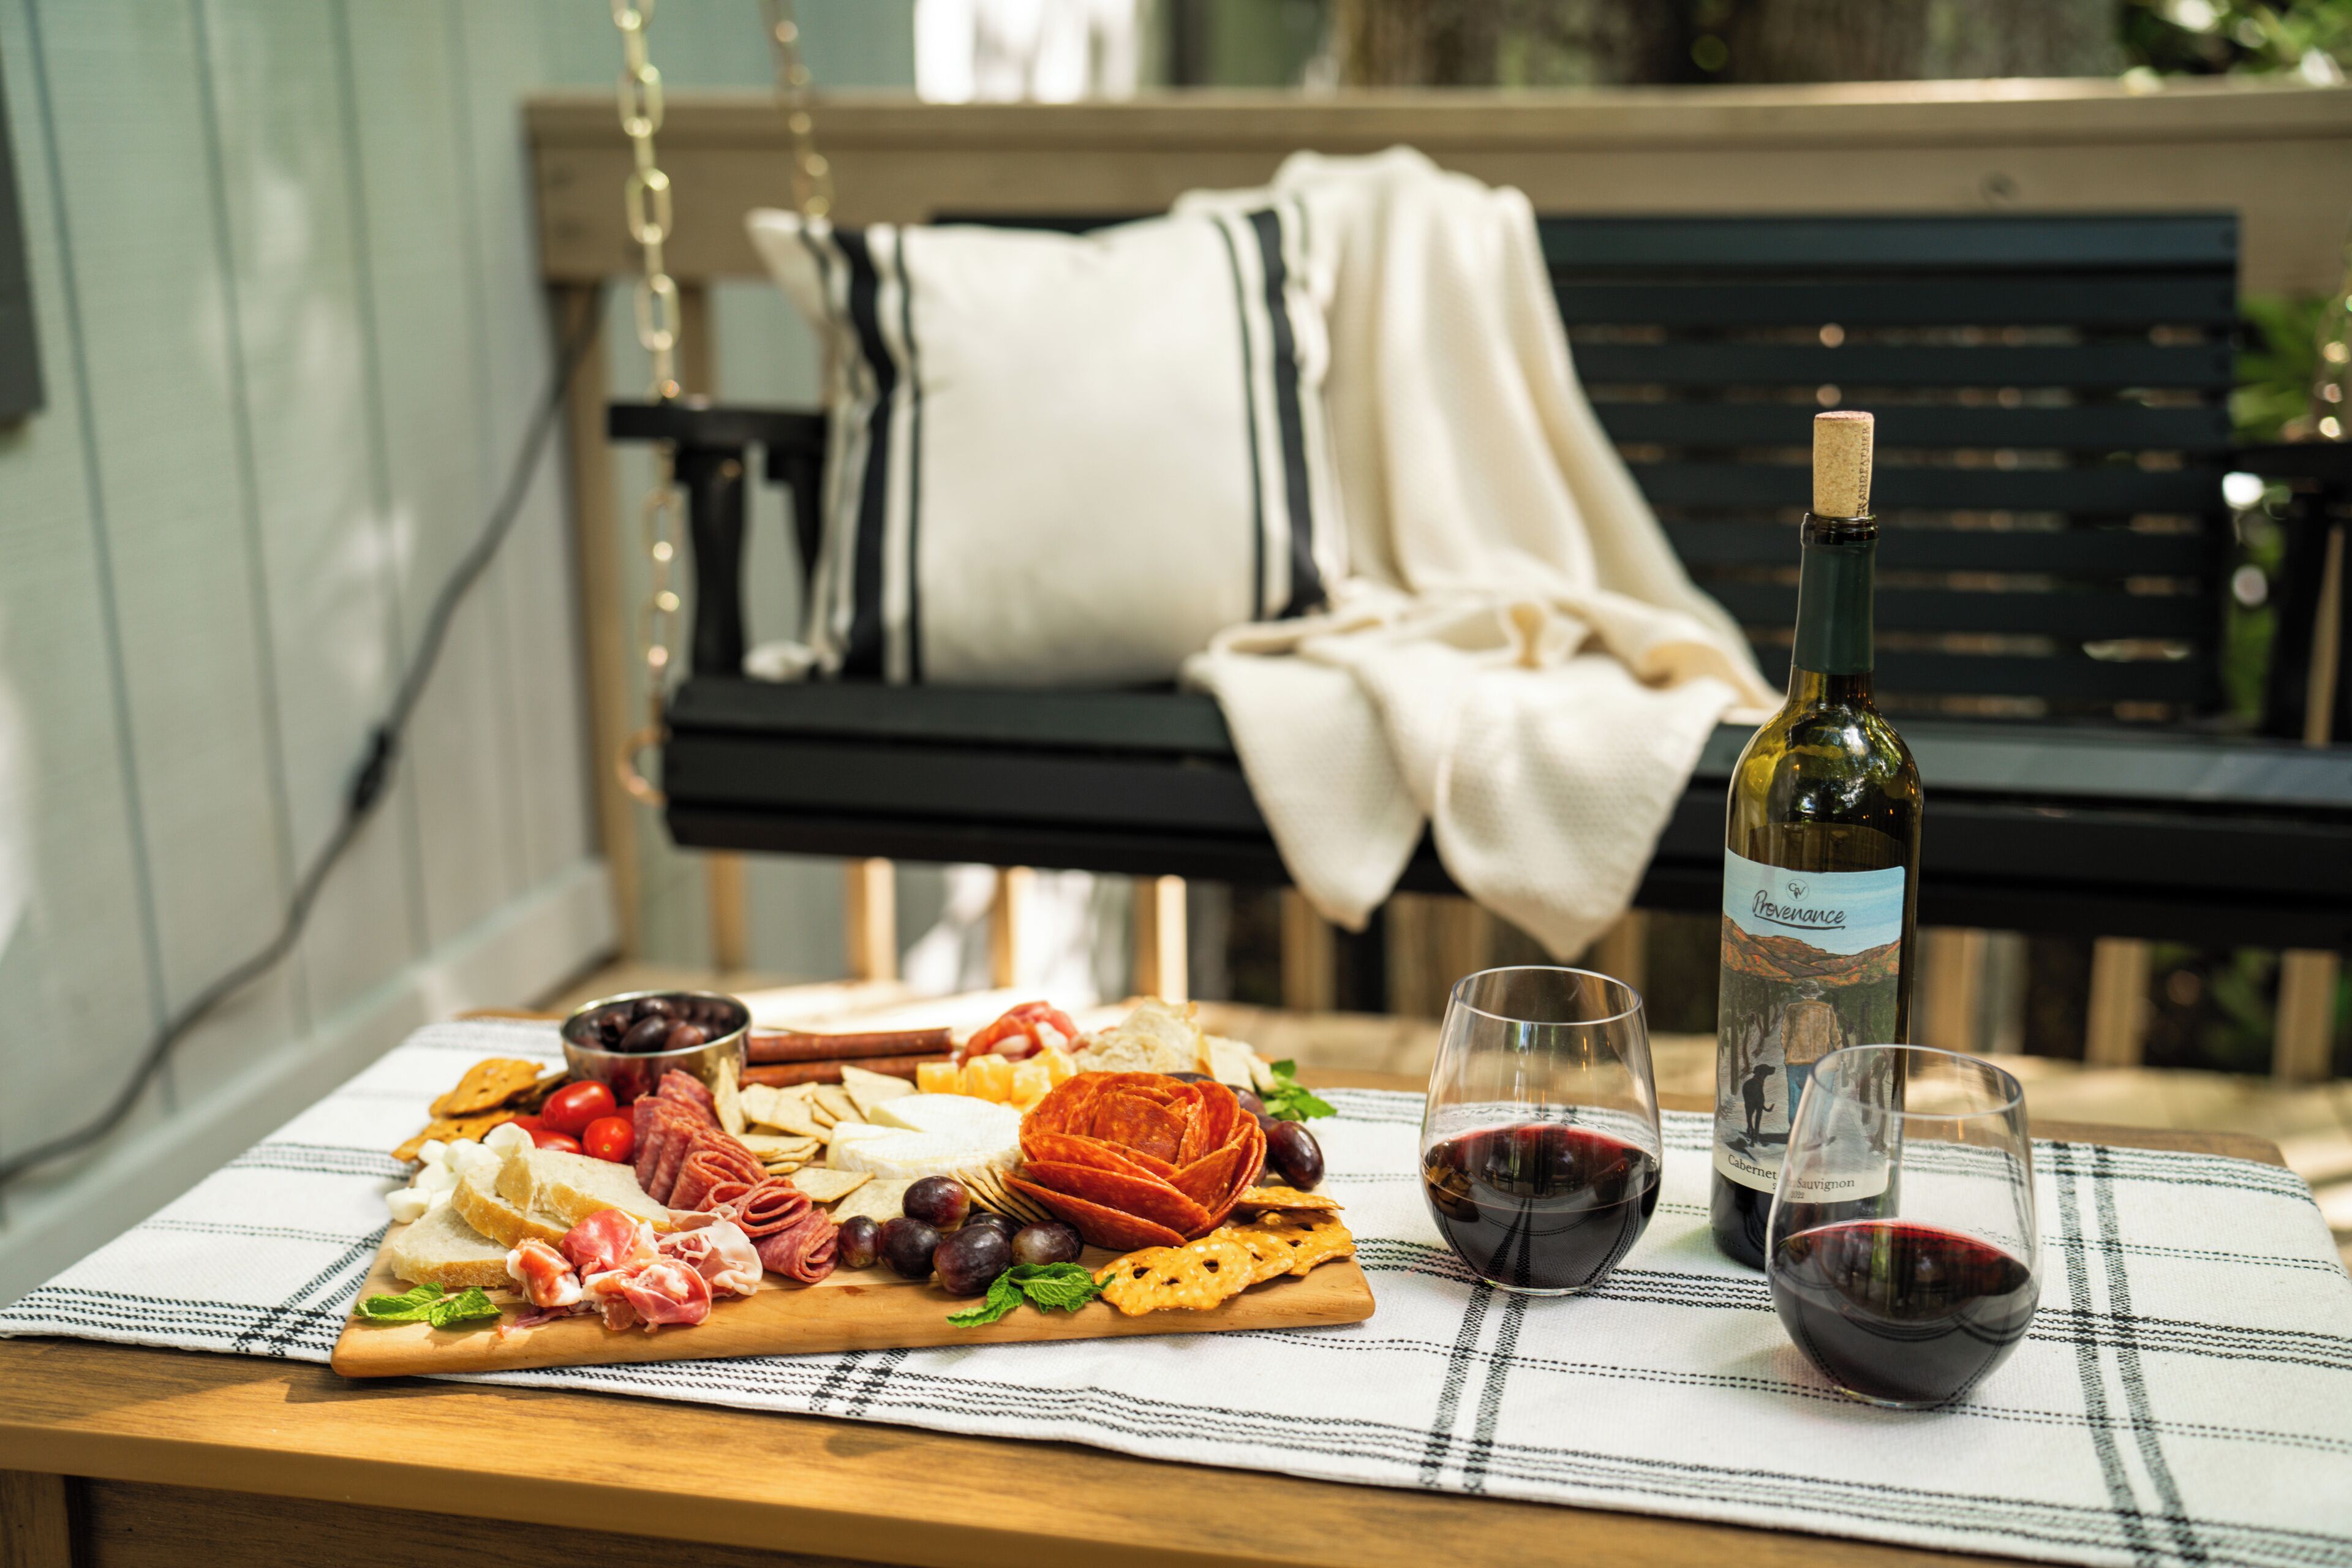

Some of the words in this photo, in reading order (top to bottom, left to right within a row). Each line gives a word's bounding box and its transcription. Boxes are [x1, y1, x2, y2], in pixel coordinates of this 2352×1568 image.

[1752, 889, 1847, 925] Provenance
[1728, 1154, 1777, 1180] Cabernet
[1797, 1177, 1855, 1192] Sauvignon
